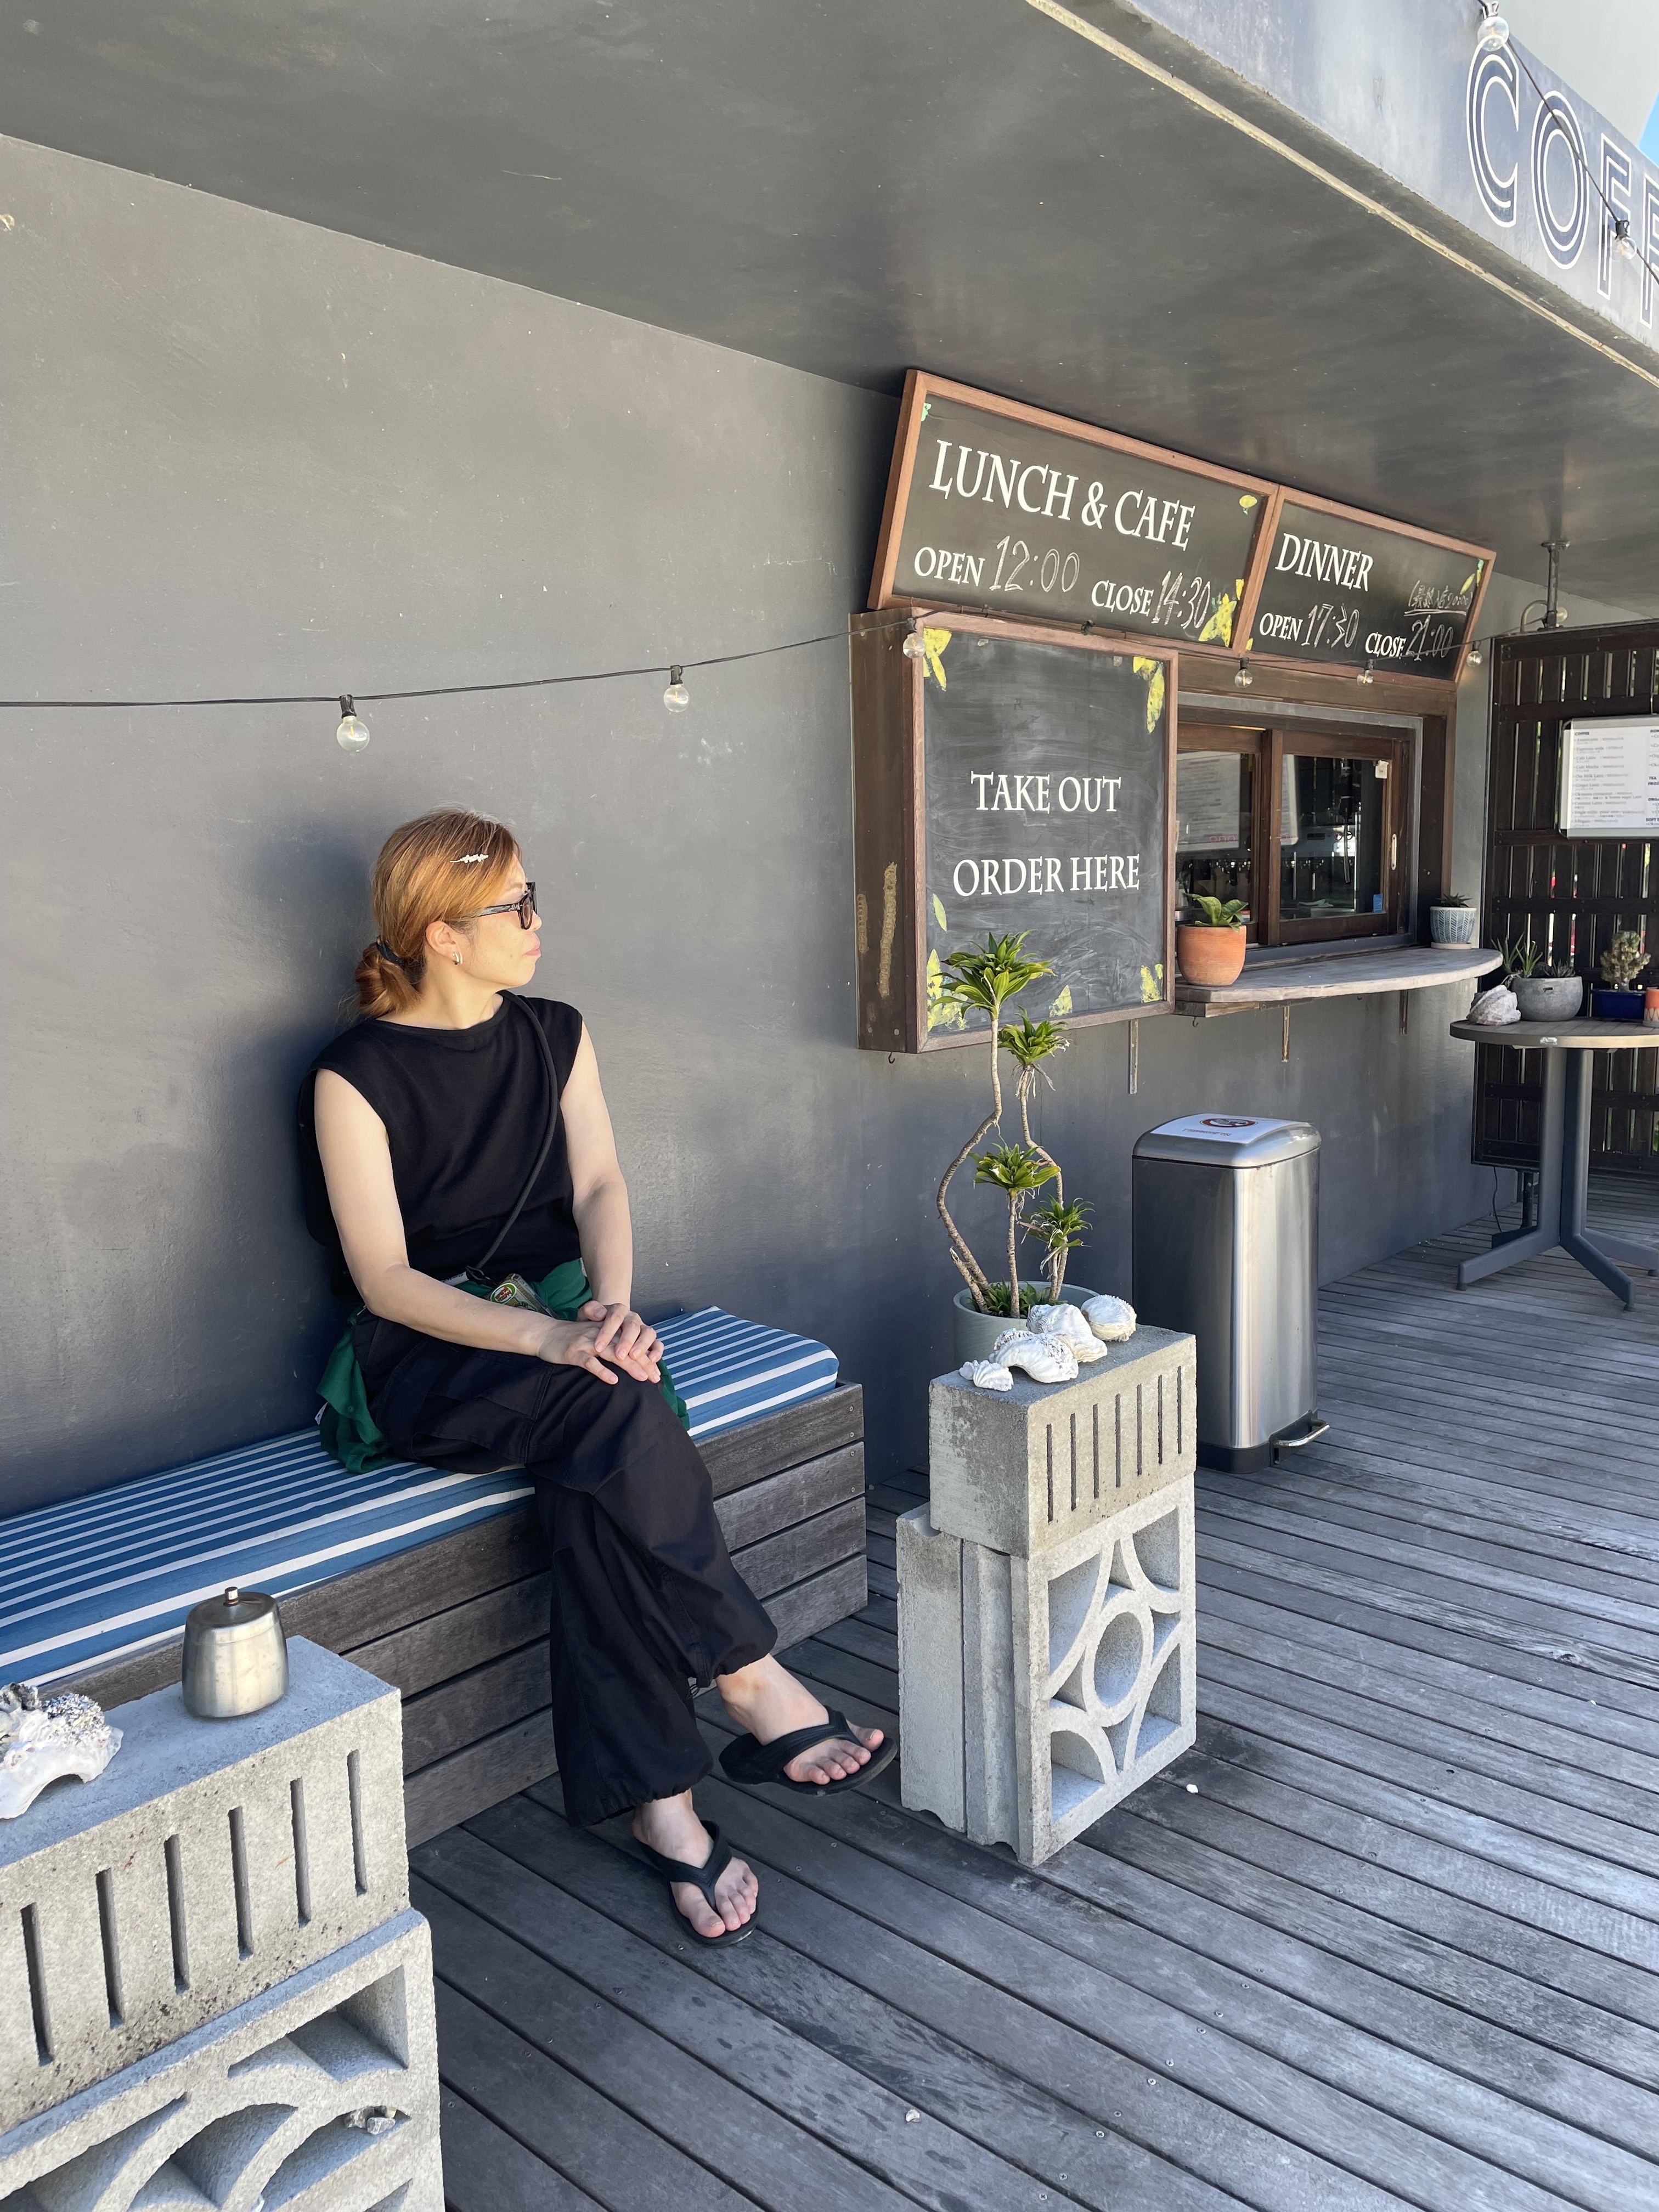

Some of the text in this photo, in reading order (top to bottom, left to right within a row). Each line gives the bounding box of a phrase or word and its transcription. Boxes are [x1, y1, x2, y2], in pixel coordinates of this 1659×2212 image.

[929, 439, 1196, 551] LUNCH & CAFE
[914, 535, 1211, 629] OPEN 12:00 CLOSE 14:30
[1275, 533, 1374, 592] DINNER
[1259, 603, 1454, 662] OPEN 17:30 CLOSE 21:00
[970, 770, 1121, 814] TAKE OUT
[953, 853, 1140, 897] ORDER HERE
